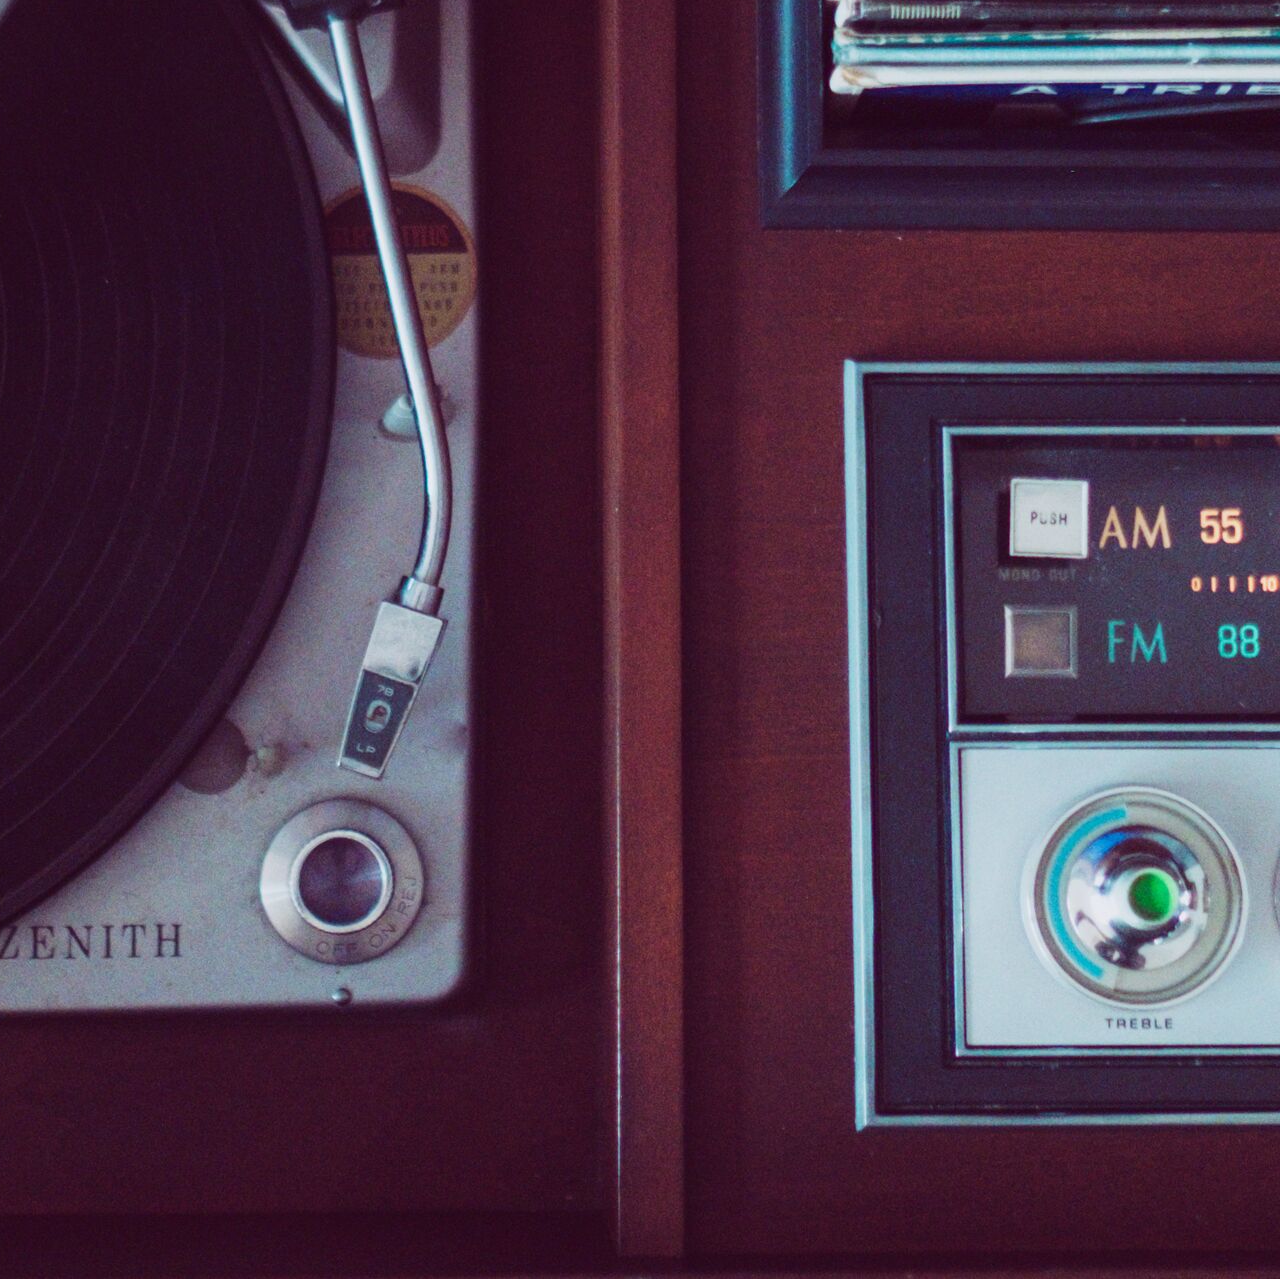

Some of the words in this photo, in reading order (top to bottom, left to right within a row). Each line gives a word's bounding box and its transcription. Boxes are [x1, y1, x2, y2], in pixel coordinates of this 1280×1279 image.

[1029, 510, 1068, 527] PUSH
[1099, 505, 1172, 549] AM
[1199, 508, 1244, 545] 55
[998, 567, 1041, 582] MONO
[1260, 577, 1279, 592] 10
[1107, 621, 1167, 664] FM
[1217, 624, 1260, 660] 88
[377, 685, 395, 697] 78
[356, 743, 377, 754] LP
[397, 877, 418, 917] REJ
[369, 923, 396, 949] ON
[1105, 1017, 1174, 1031] TREBLE
